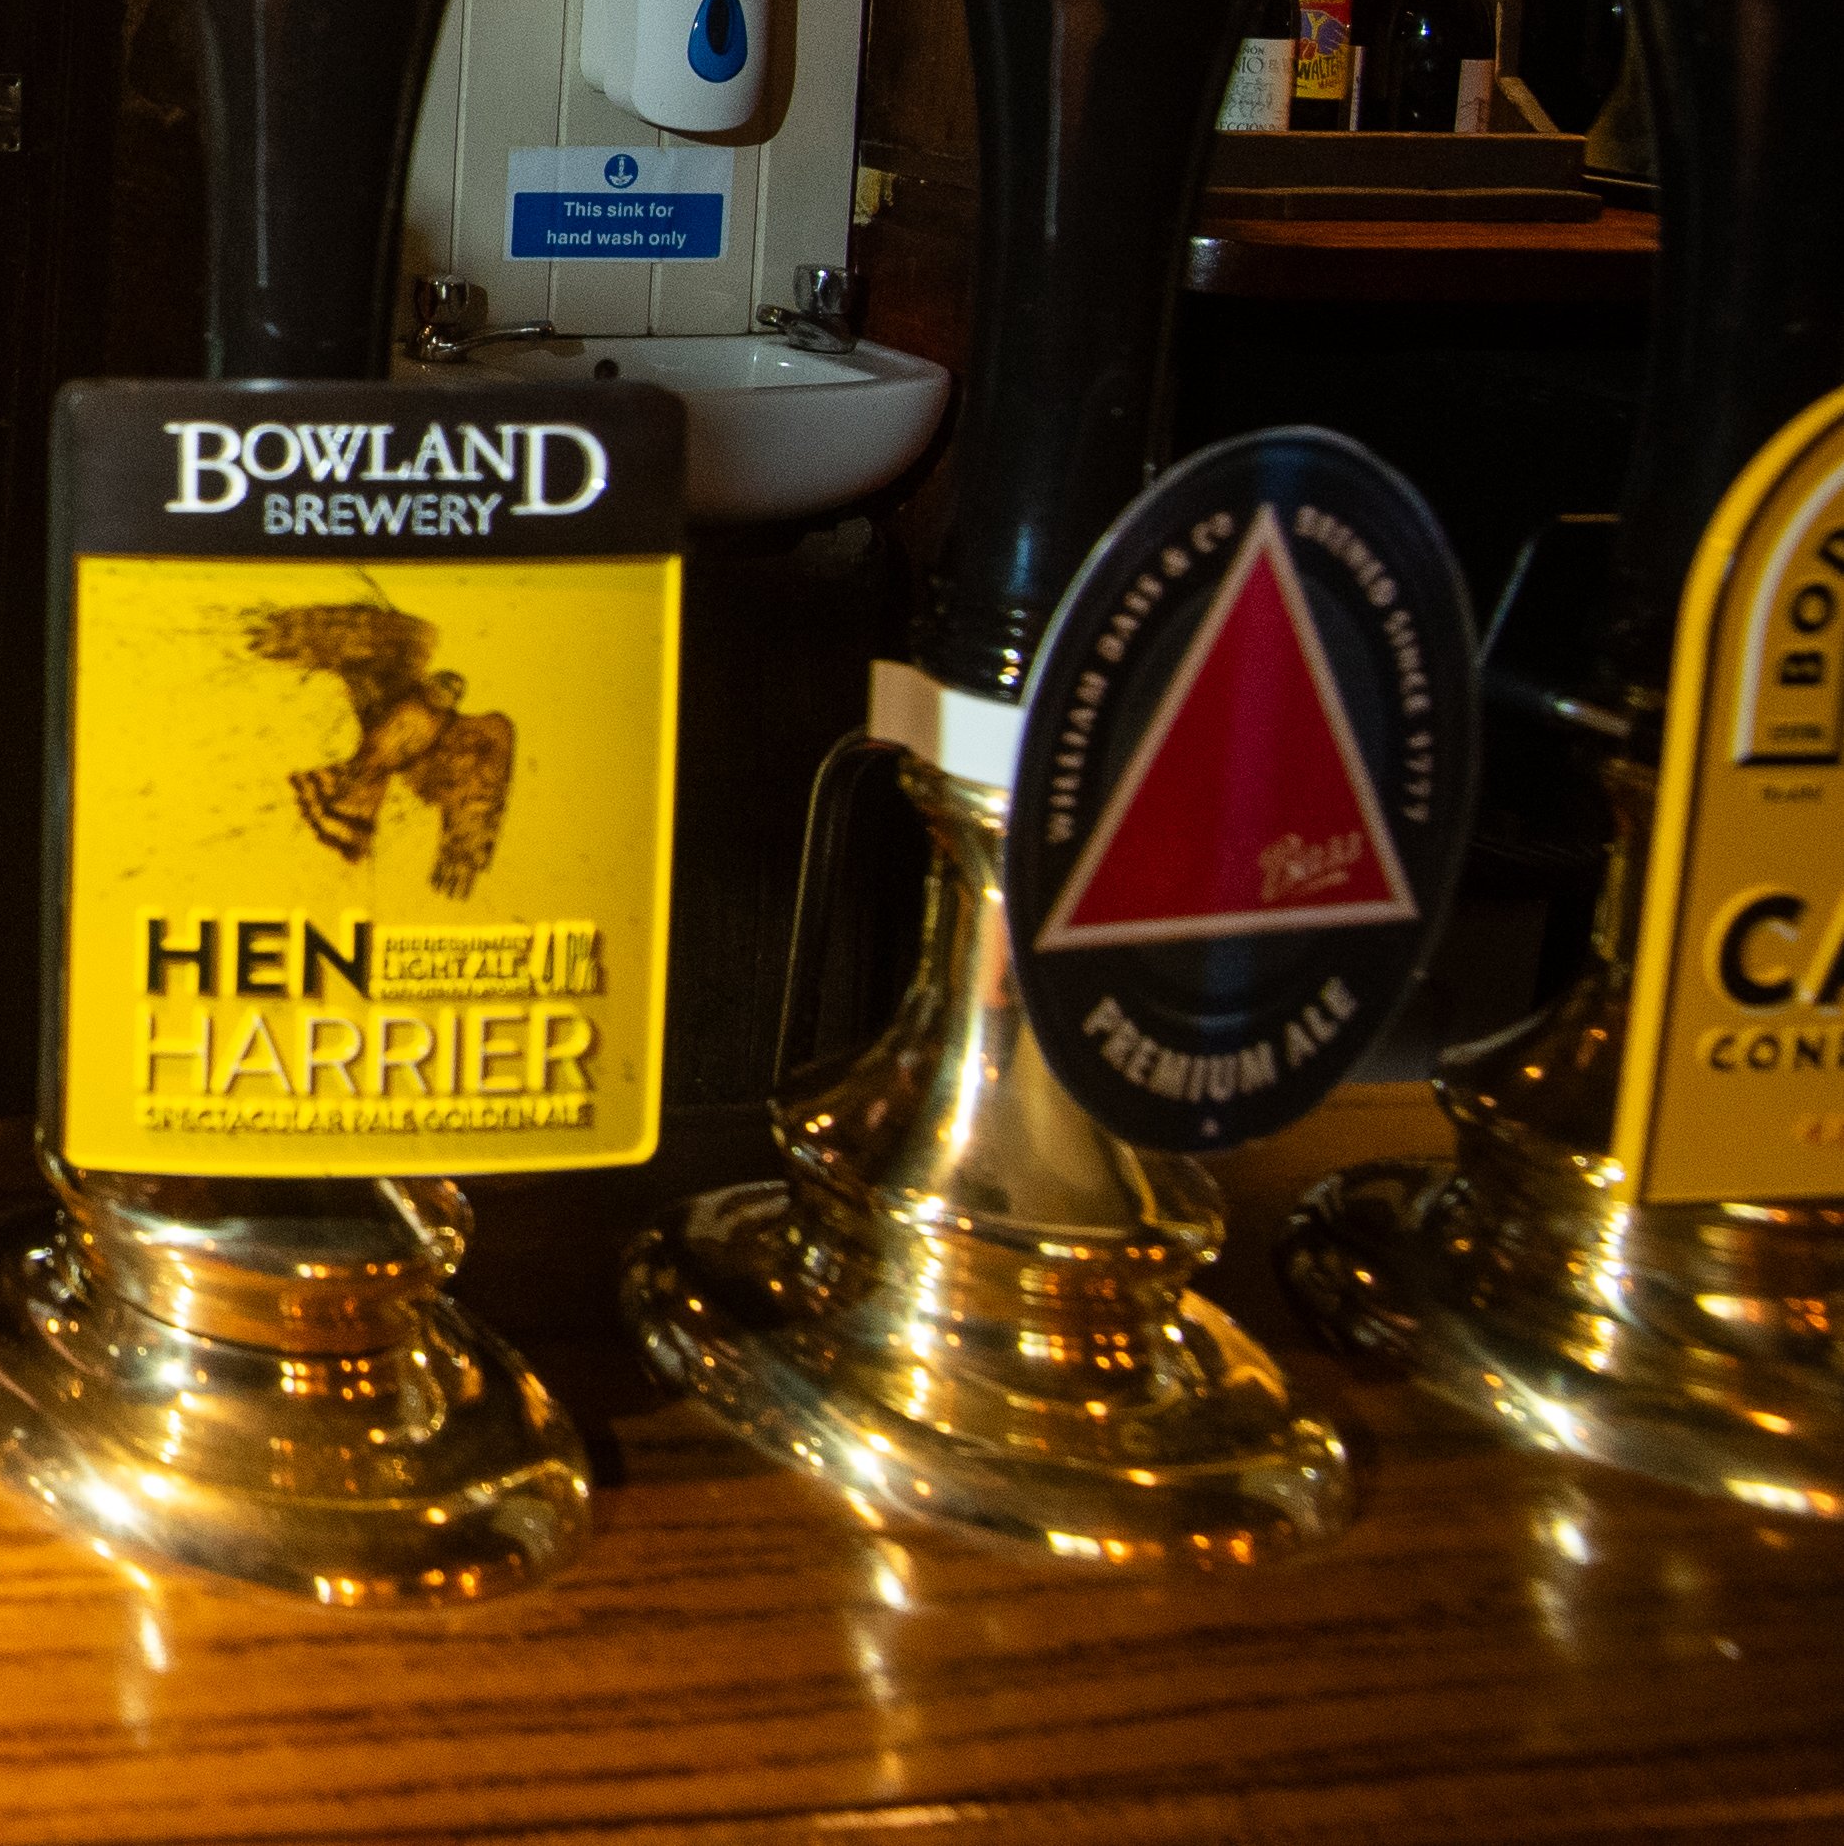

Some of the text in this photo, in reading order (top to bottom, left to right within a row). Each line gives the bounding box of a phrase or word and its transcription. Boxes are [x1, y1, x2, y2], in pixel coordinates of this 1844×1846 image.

[545, 229, 688, 250] hand wash only
[563, 200, 675, 218] This sink for
[164, 421, 609, 517] BOWLAND
[263, 492, 502, 537] BREWERY
[1257, 830, 1366, 905] Bass
[143, 916, 375, 1000] HEN
[139, 1005, 598, 1099] HARRIER
[1081, 974, 1360, 1105] PREMIUM ALE
